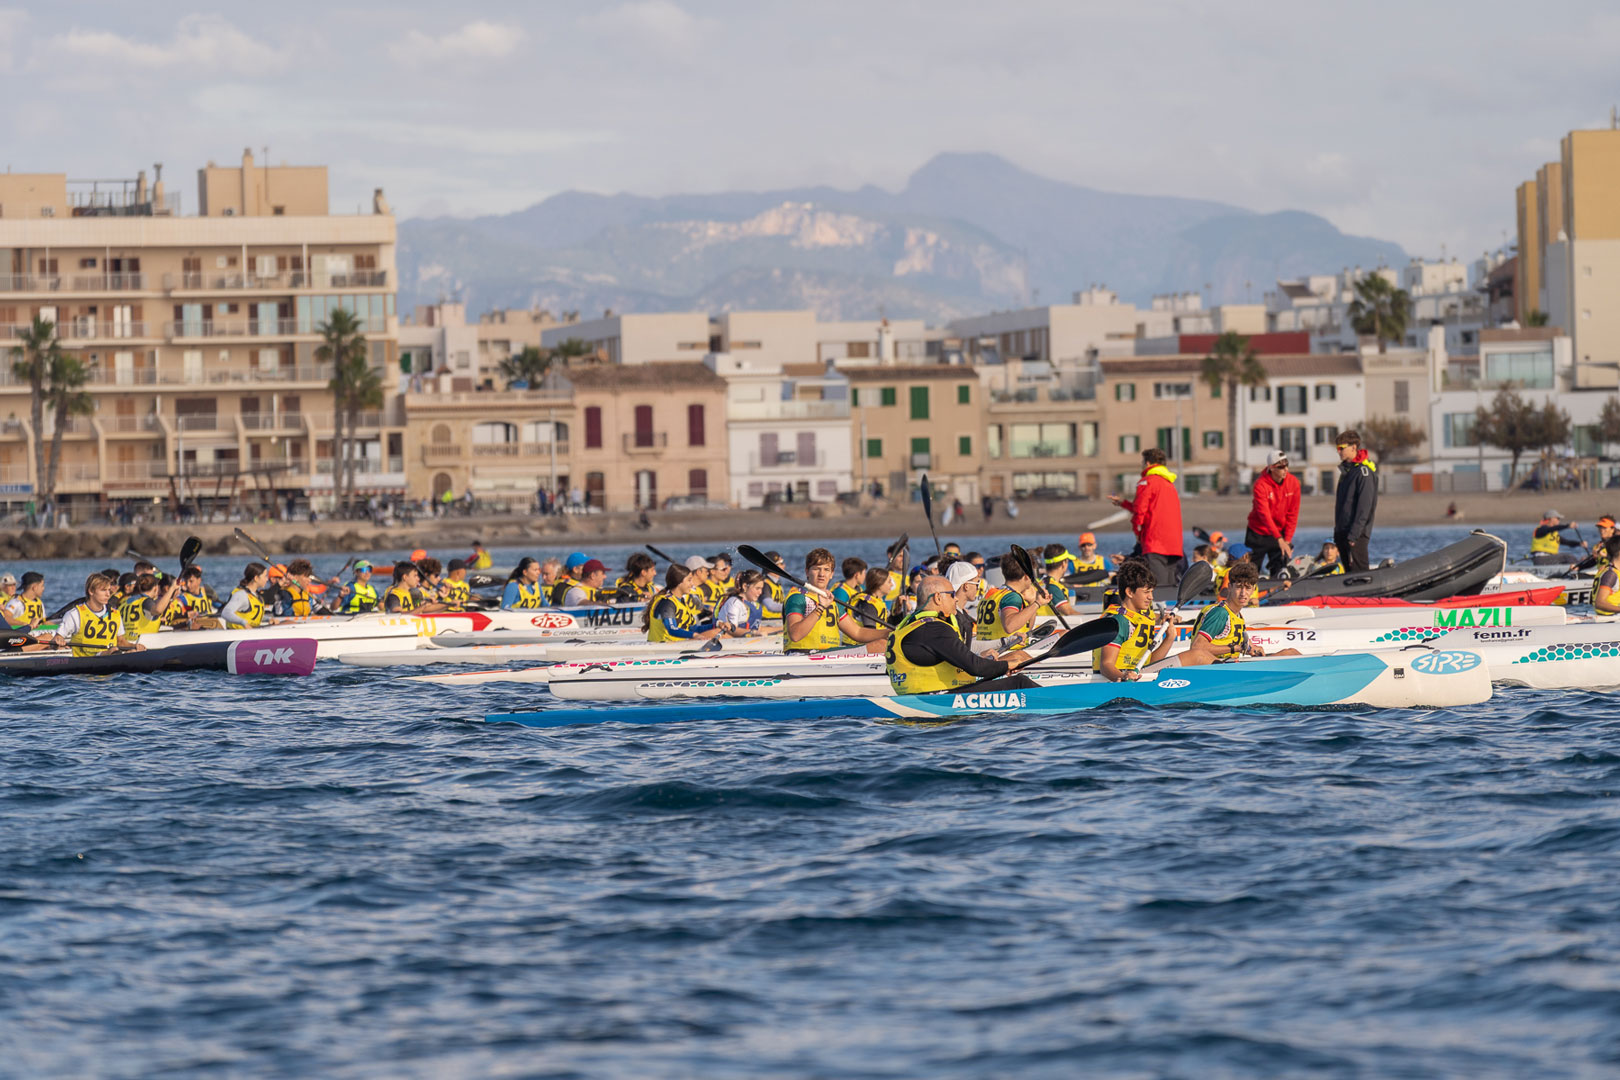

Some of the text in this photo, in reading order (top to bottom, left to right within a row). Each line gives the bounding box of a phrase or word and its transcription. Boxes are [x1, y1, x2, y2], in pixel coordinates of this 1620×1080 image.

[586, 607, 633, 627] MAZU
[84, 620, 117, 640] 629
[1286, 630, 1317, 642] 512
[1473, 628, 1532, 640] fenn.fr
[951, 692, 1021, 709] ACKUA
